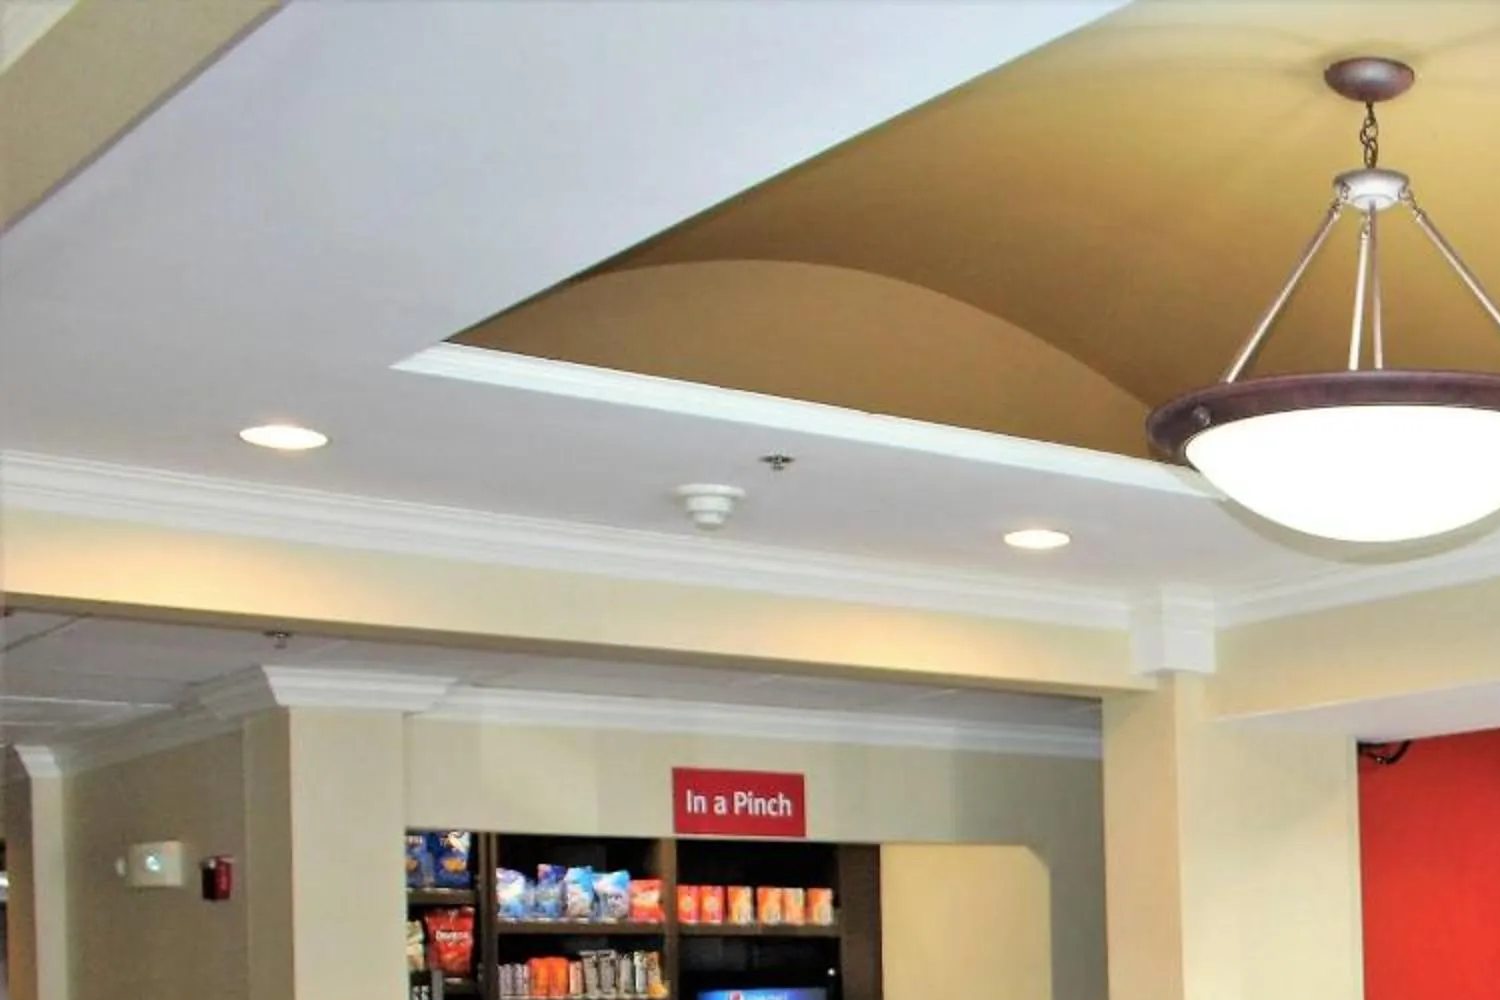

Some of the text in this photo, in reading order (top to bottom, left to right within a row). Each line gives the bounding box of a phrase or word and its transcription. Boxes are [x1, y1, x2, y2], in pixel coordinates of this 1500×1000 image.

[686, 789, 793, 817] In a Pinch
